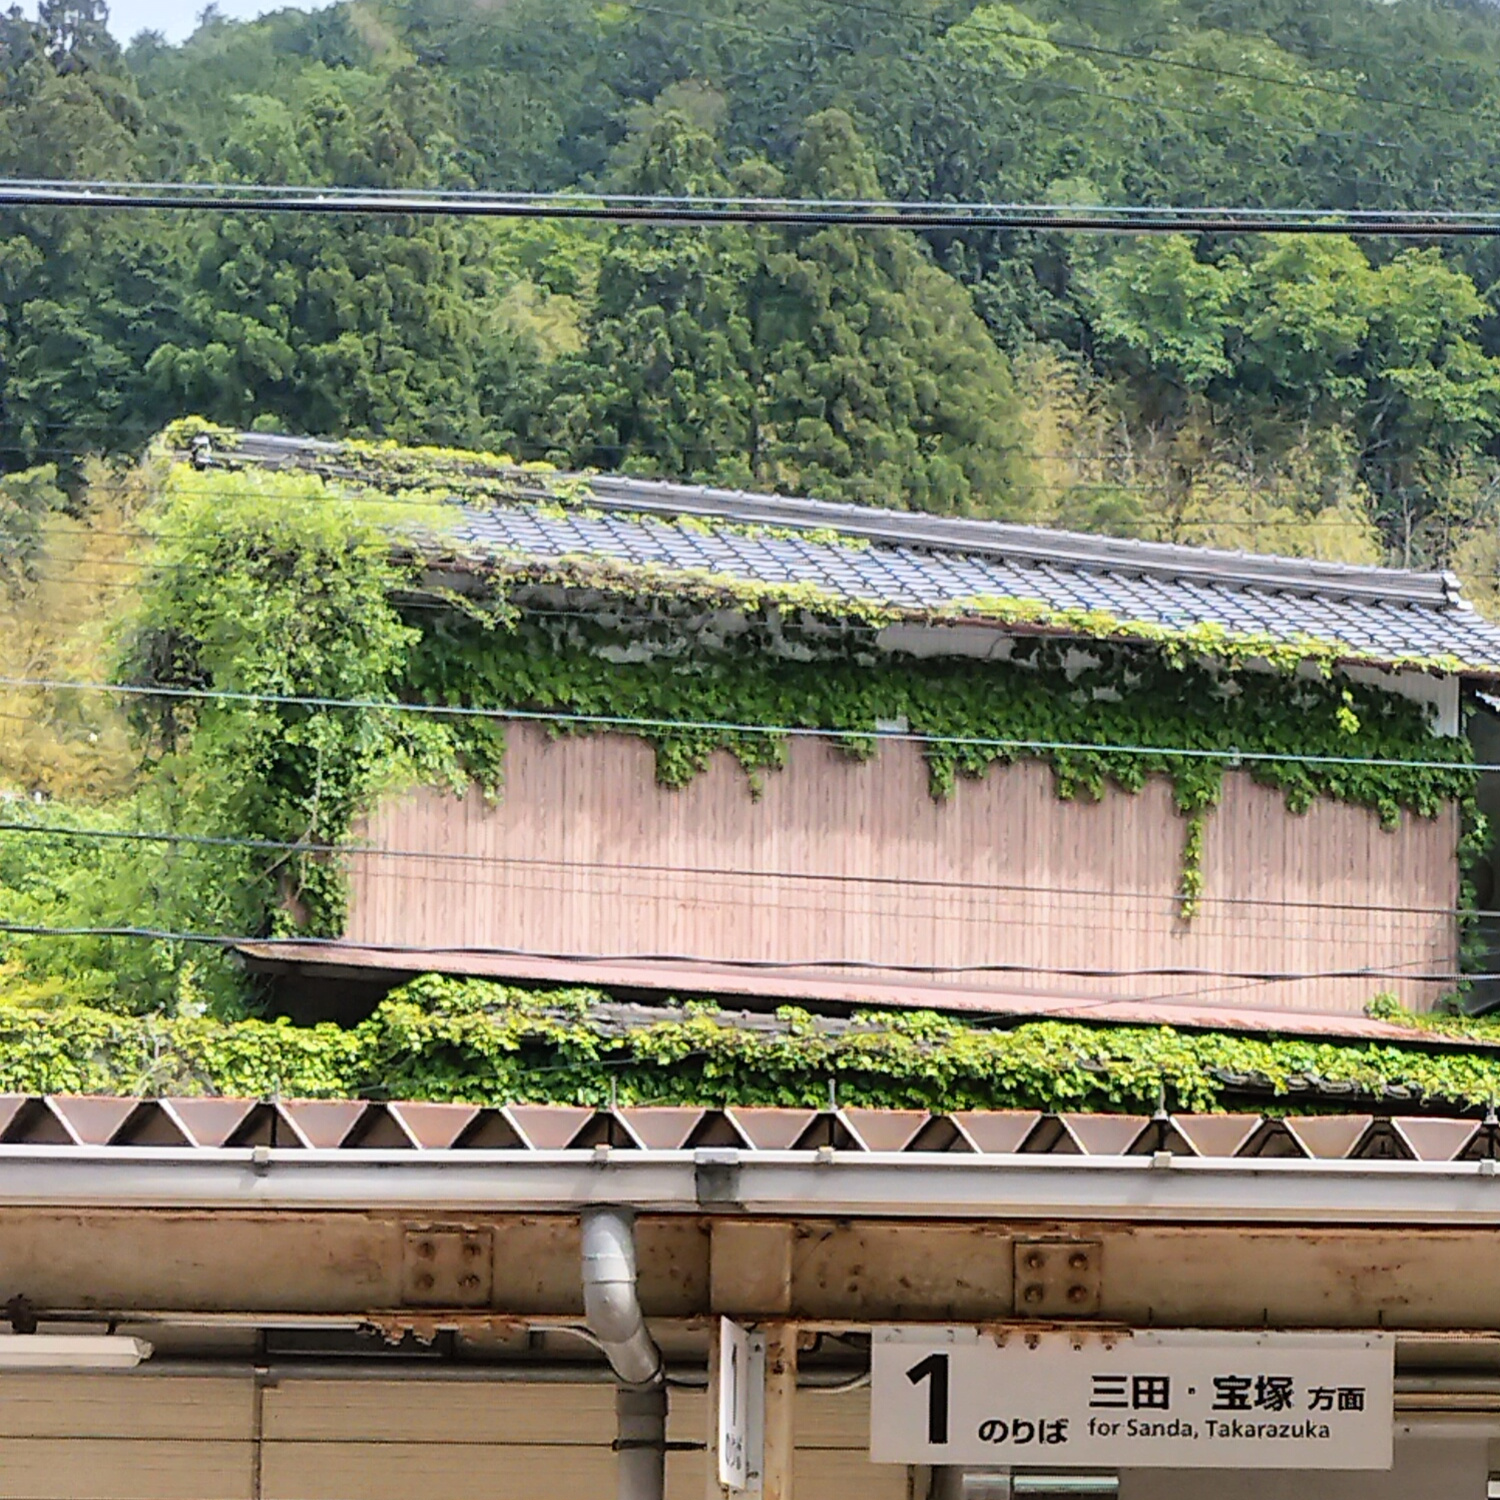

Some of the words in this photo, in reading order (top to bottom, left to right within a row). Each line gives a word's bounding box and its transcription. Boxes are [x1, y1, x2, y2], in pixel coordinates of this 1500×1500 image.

[905, 1353, 949, 1445] 1
[977, 1417, 1070, 1445] のりば
[1307, 1386, 1367, 1412] 方面
[1088, 1417, 1120, 1438] for
[1126, 1418, 1199, 1440] Sanda,
[1205, 1418, 1330, 1439] Takarazuka
